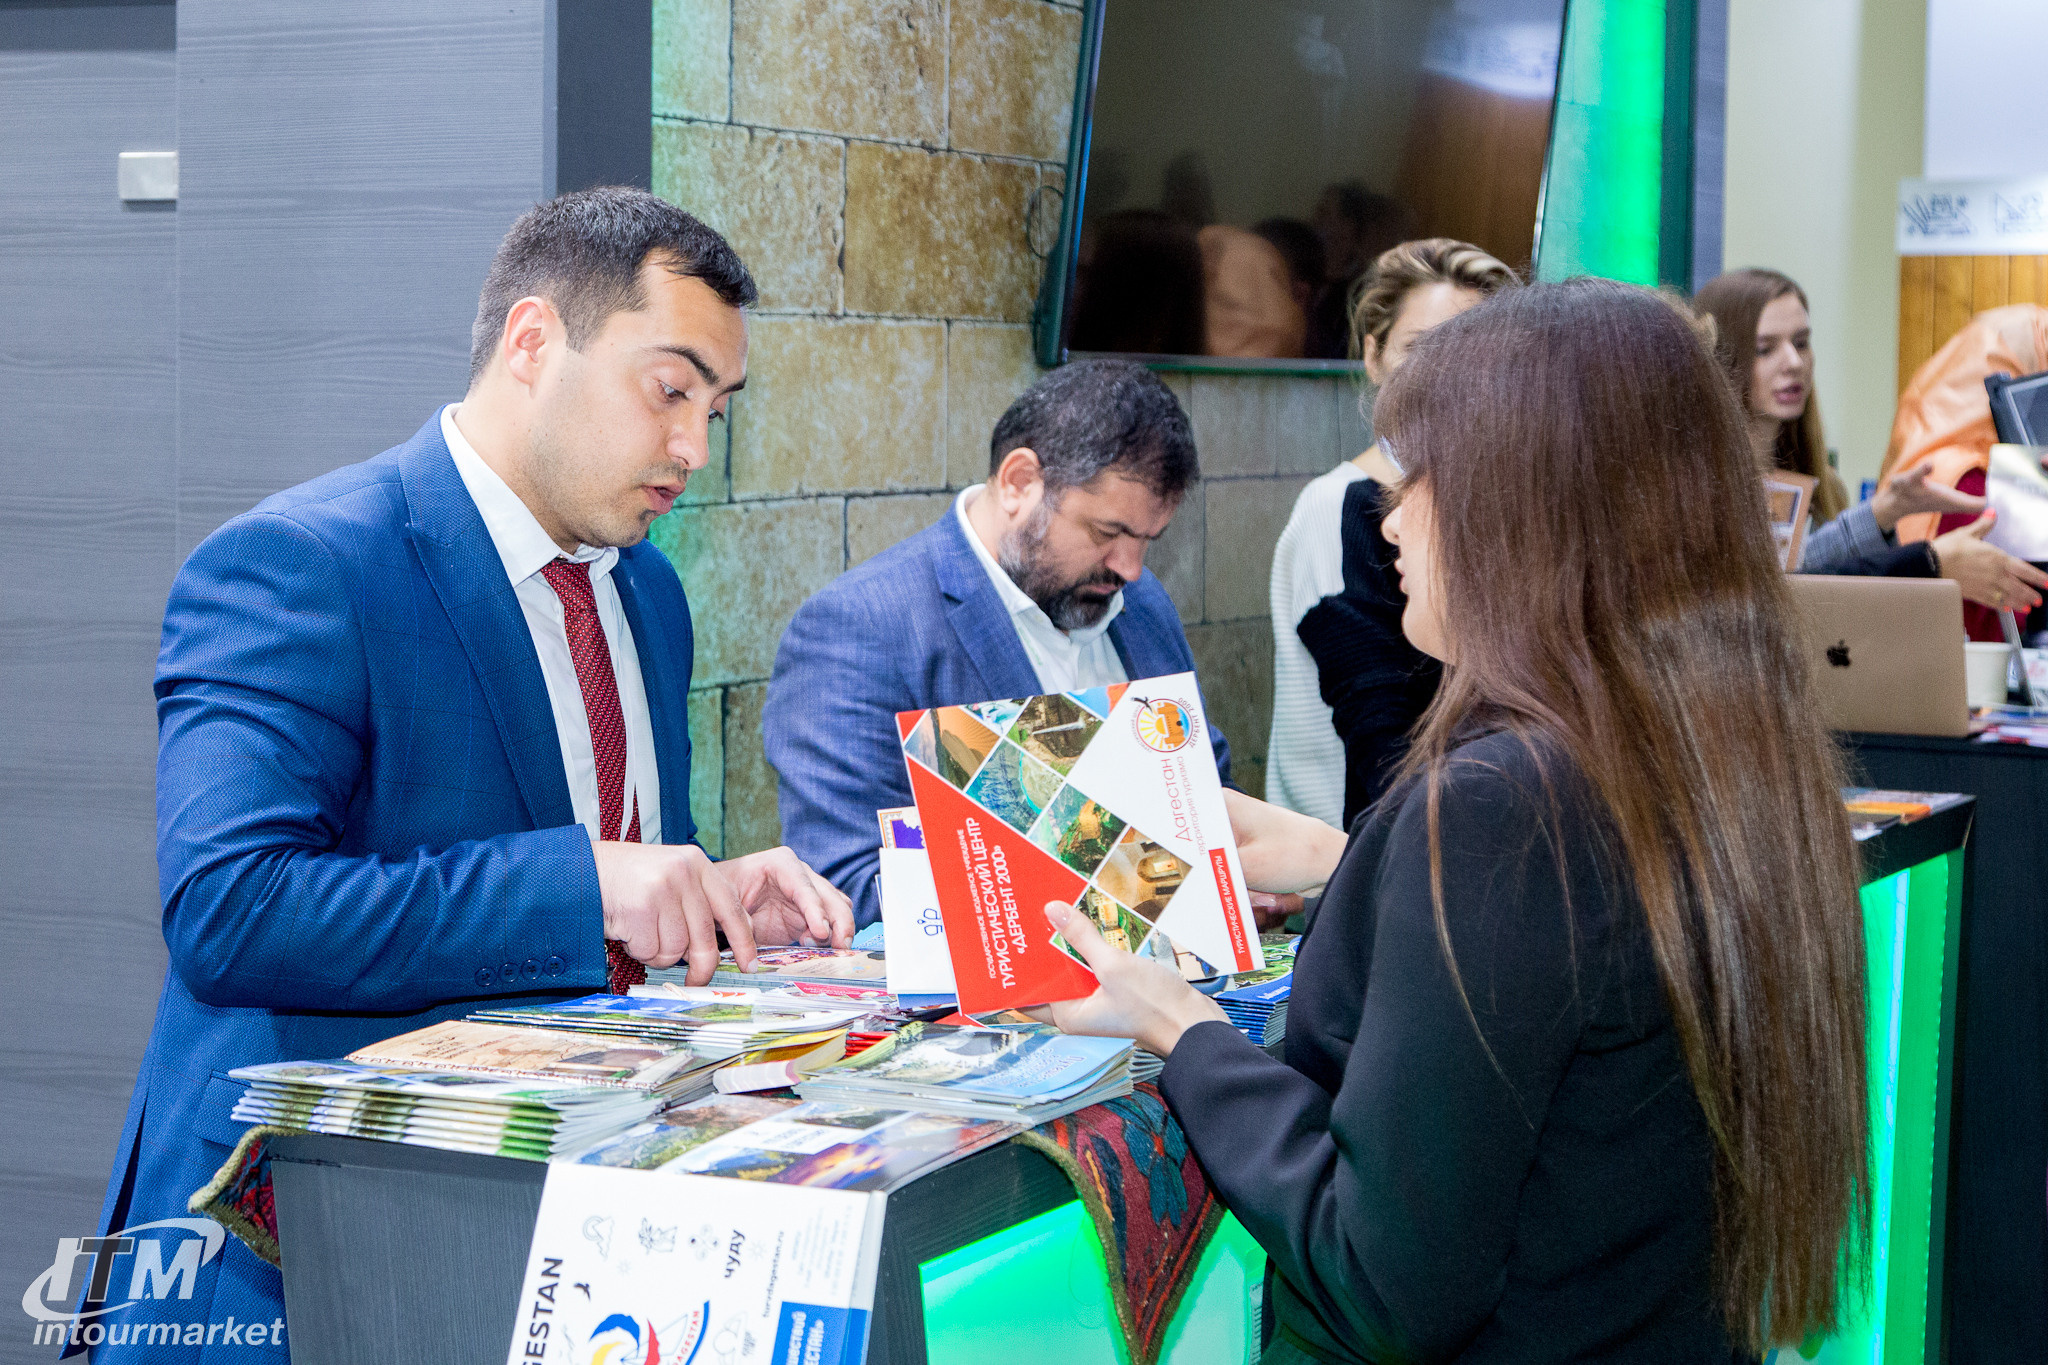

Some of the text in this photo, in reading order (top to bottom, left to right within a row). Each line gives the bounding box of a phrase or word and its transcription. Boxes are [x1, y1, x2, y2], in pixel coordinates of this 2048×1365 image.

[1188, 714, 1201, 749] ДЕРБЕНТ
[1161, 758, 1193, 841] Дагестан
[1176, 756, 1206, 856] территория туризма
[957, 828, 972, 871] УЧРЕЖДЕНИЕ
[965, 817, 1017, 989] ТУРИСТИЧЕСКИЙ ЦЕНТР
[991, 845, 1028, 955] «ДЕРБЕНТ 2000»
[1214, 855, 1245, 955] ТУРИСТИЧЕСКИЕ МАРШРУТЫ
[976, 915, 997, 979] ГОСУДАРСТВЕННОЕ
[723, 1229, 747, 1279] чуду
[522, 1257, 563, 1365] ESTAN
